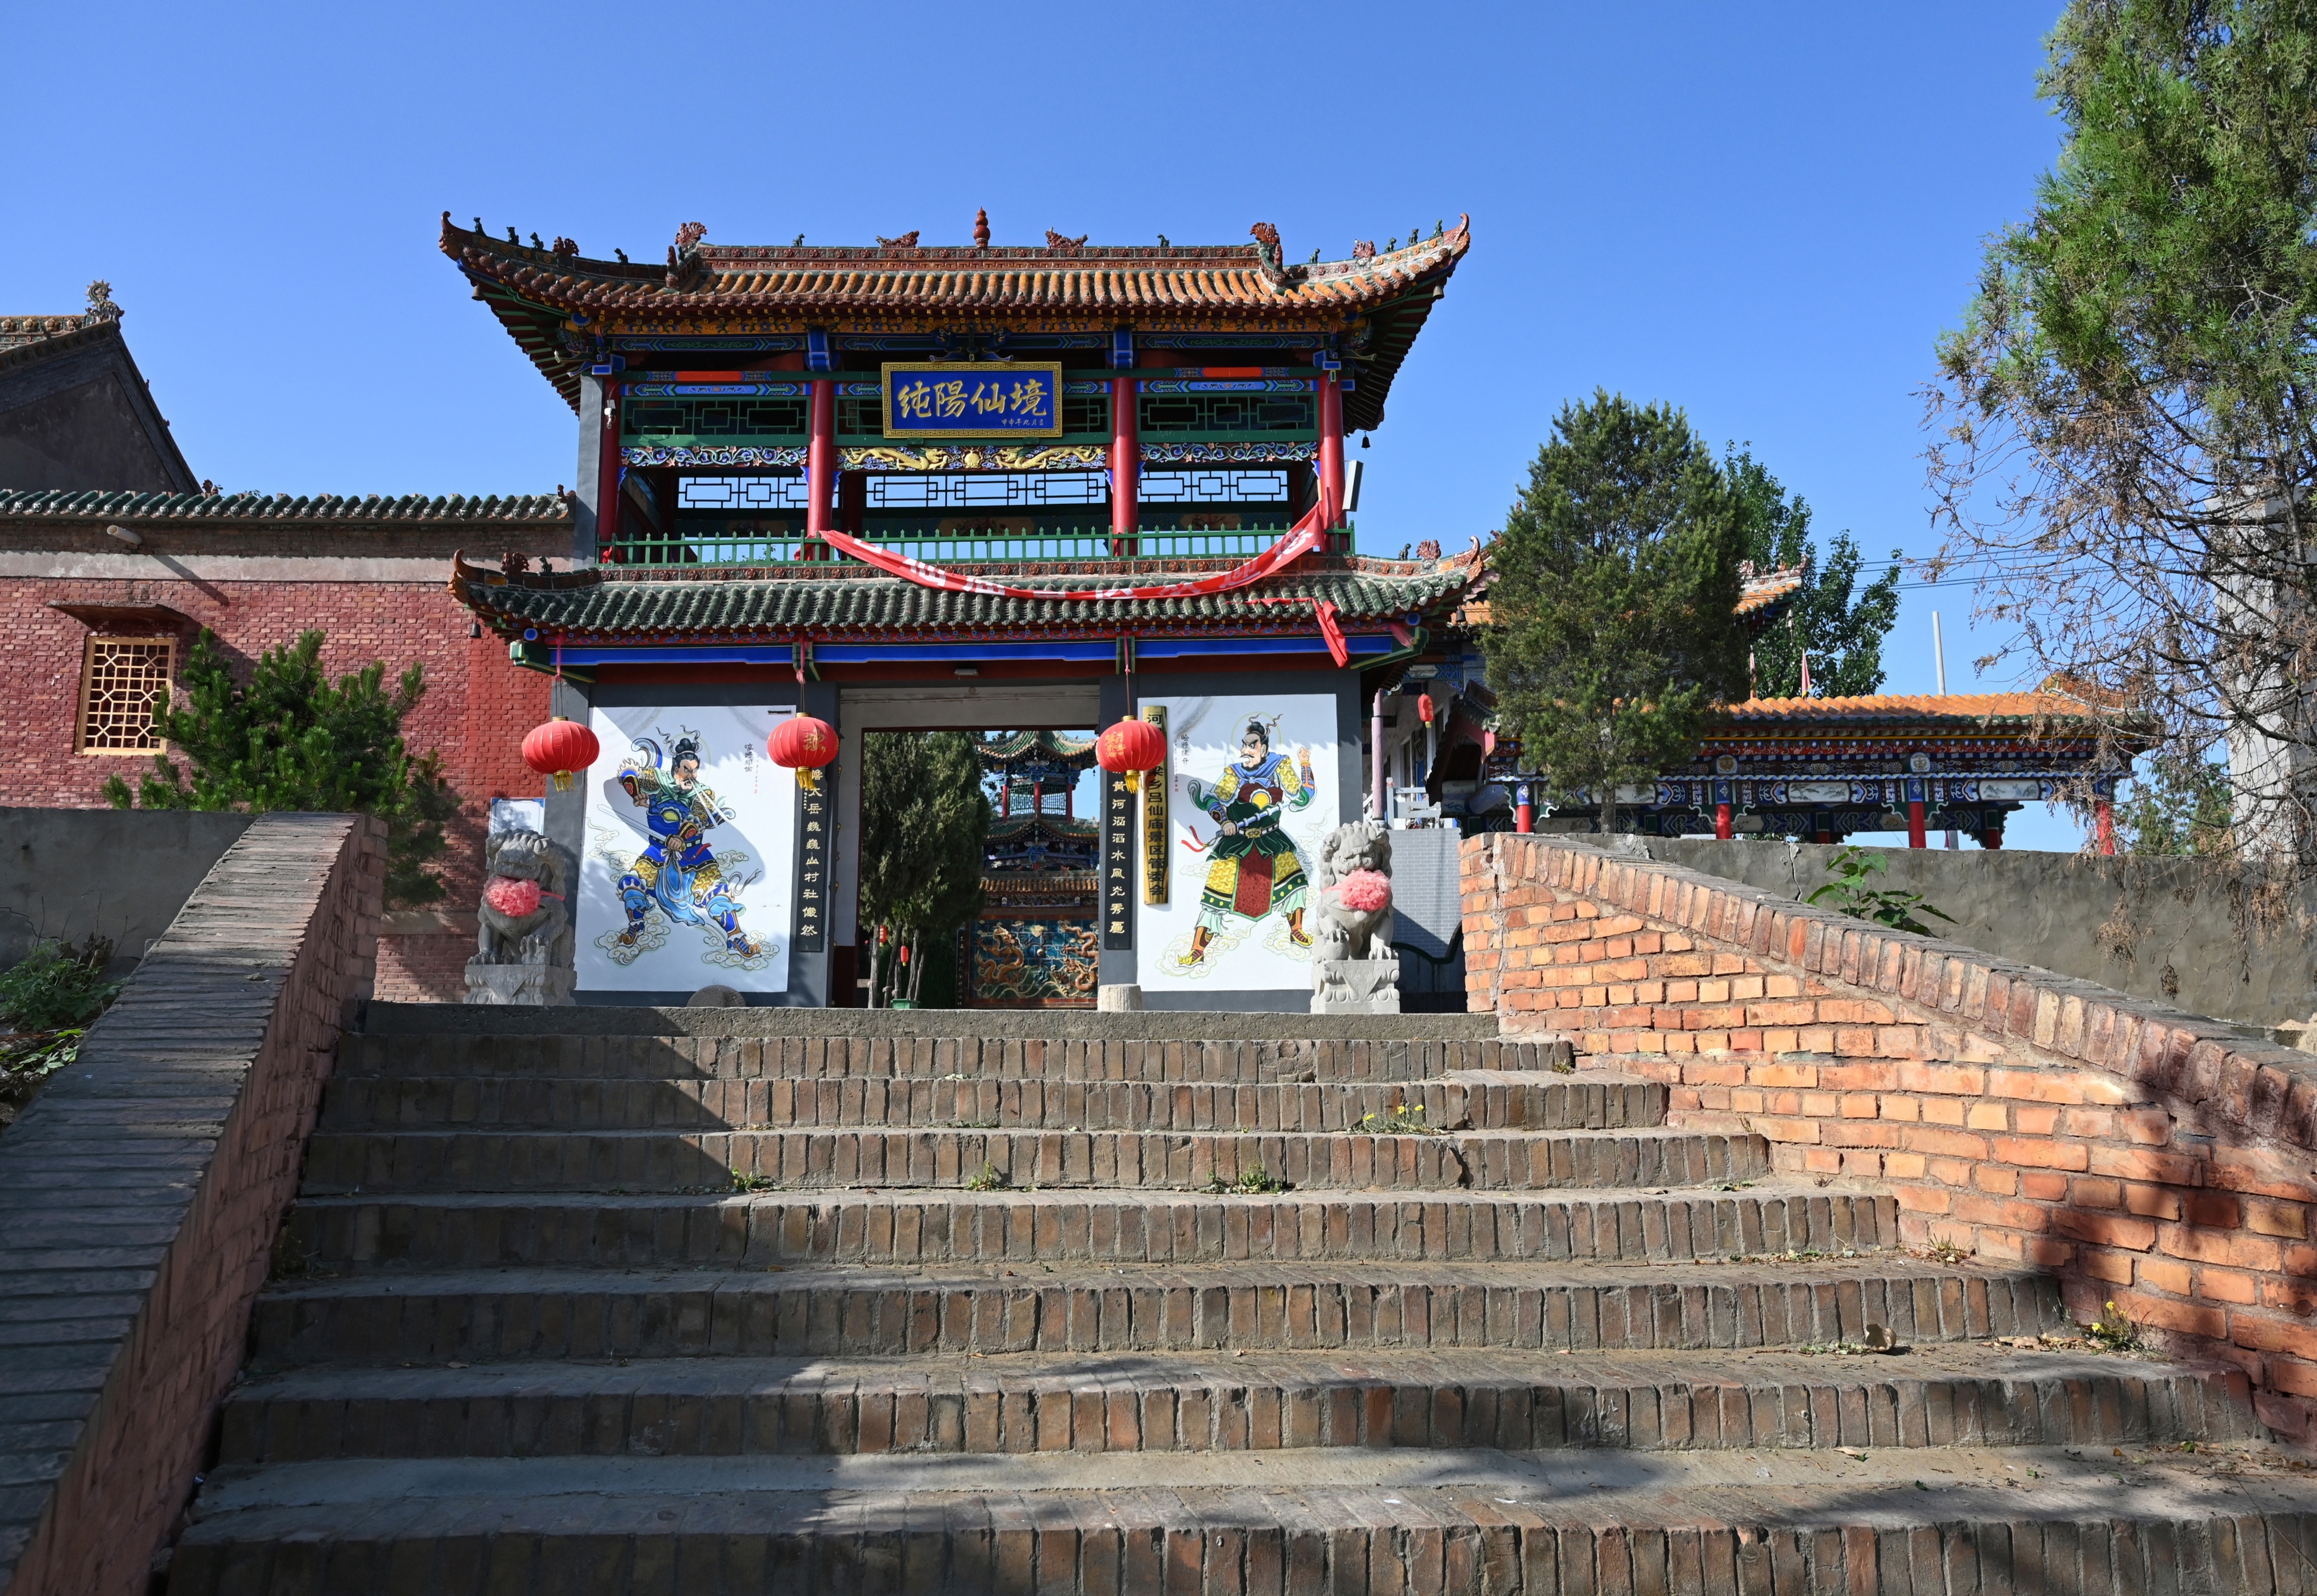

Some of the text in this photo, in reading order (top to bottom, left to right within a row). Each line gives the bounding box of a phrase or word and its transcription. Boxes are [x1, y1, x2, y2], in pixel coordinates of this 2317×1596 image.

[1001, 418, 1044, 426] 甲申年九月立
[1147, 714, 1164, 896] 河梁乡吕仙庙景区管委会
